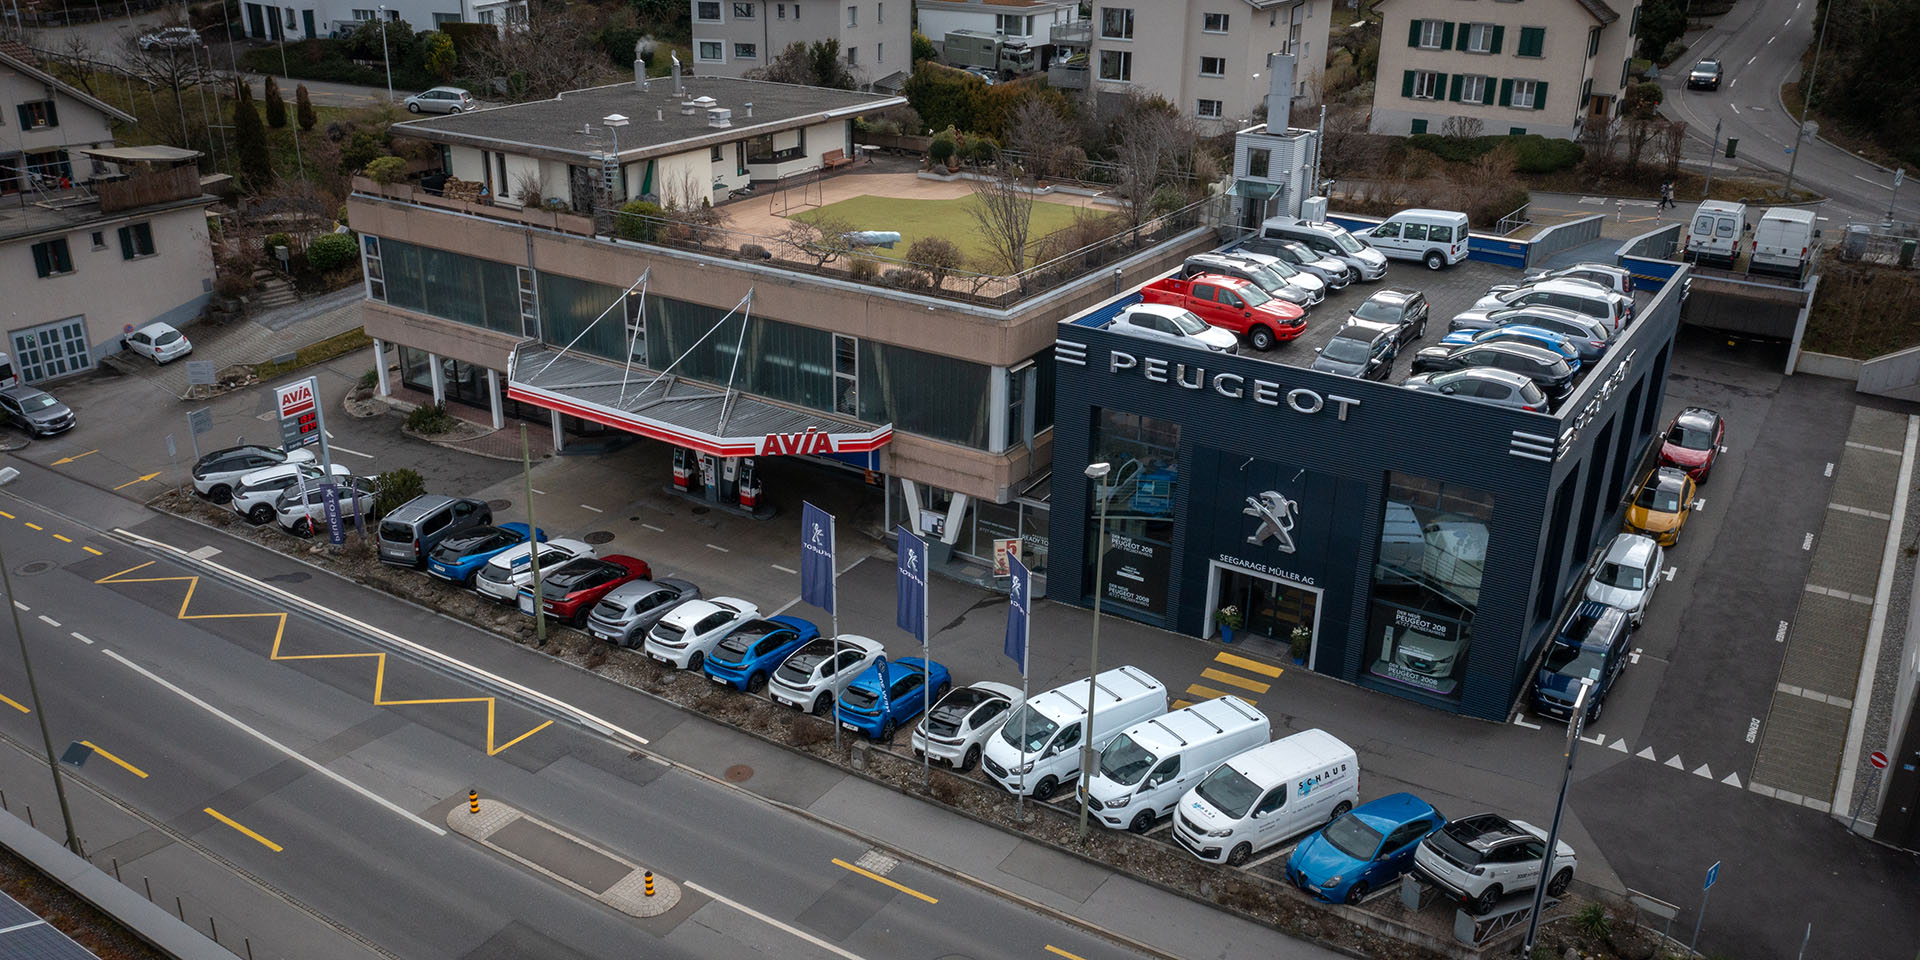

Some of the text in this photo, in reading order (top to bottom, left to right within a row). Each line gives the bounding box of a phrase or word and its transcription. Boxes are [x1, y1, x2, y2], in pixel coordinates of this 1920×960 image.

[282, 386, 312, 406] AVIA
[1110, 350, 1361, 422] PEUGEOT
[760, 426, 834, 456] AVIA
[1112, 538, 1152, 554] PEUGEOT 208
[1220, 554, 1314, 584] SEEGARAGE MÜLLER AG
[1108, 588, 1134, 598] PEUGEOT
[1396, 614, 1446, 632] PEUGEOT 208
[1775, 620, 1788, 642] DENNER
[1388, 668, 1438, 686] PEUGEOT 2008
[1745, 717, 1760, 744] DENNER
[1298, 764, 1346, 790] SCHAUB
